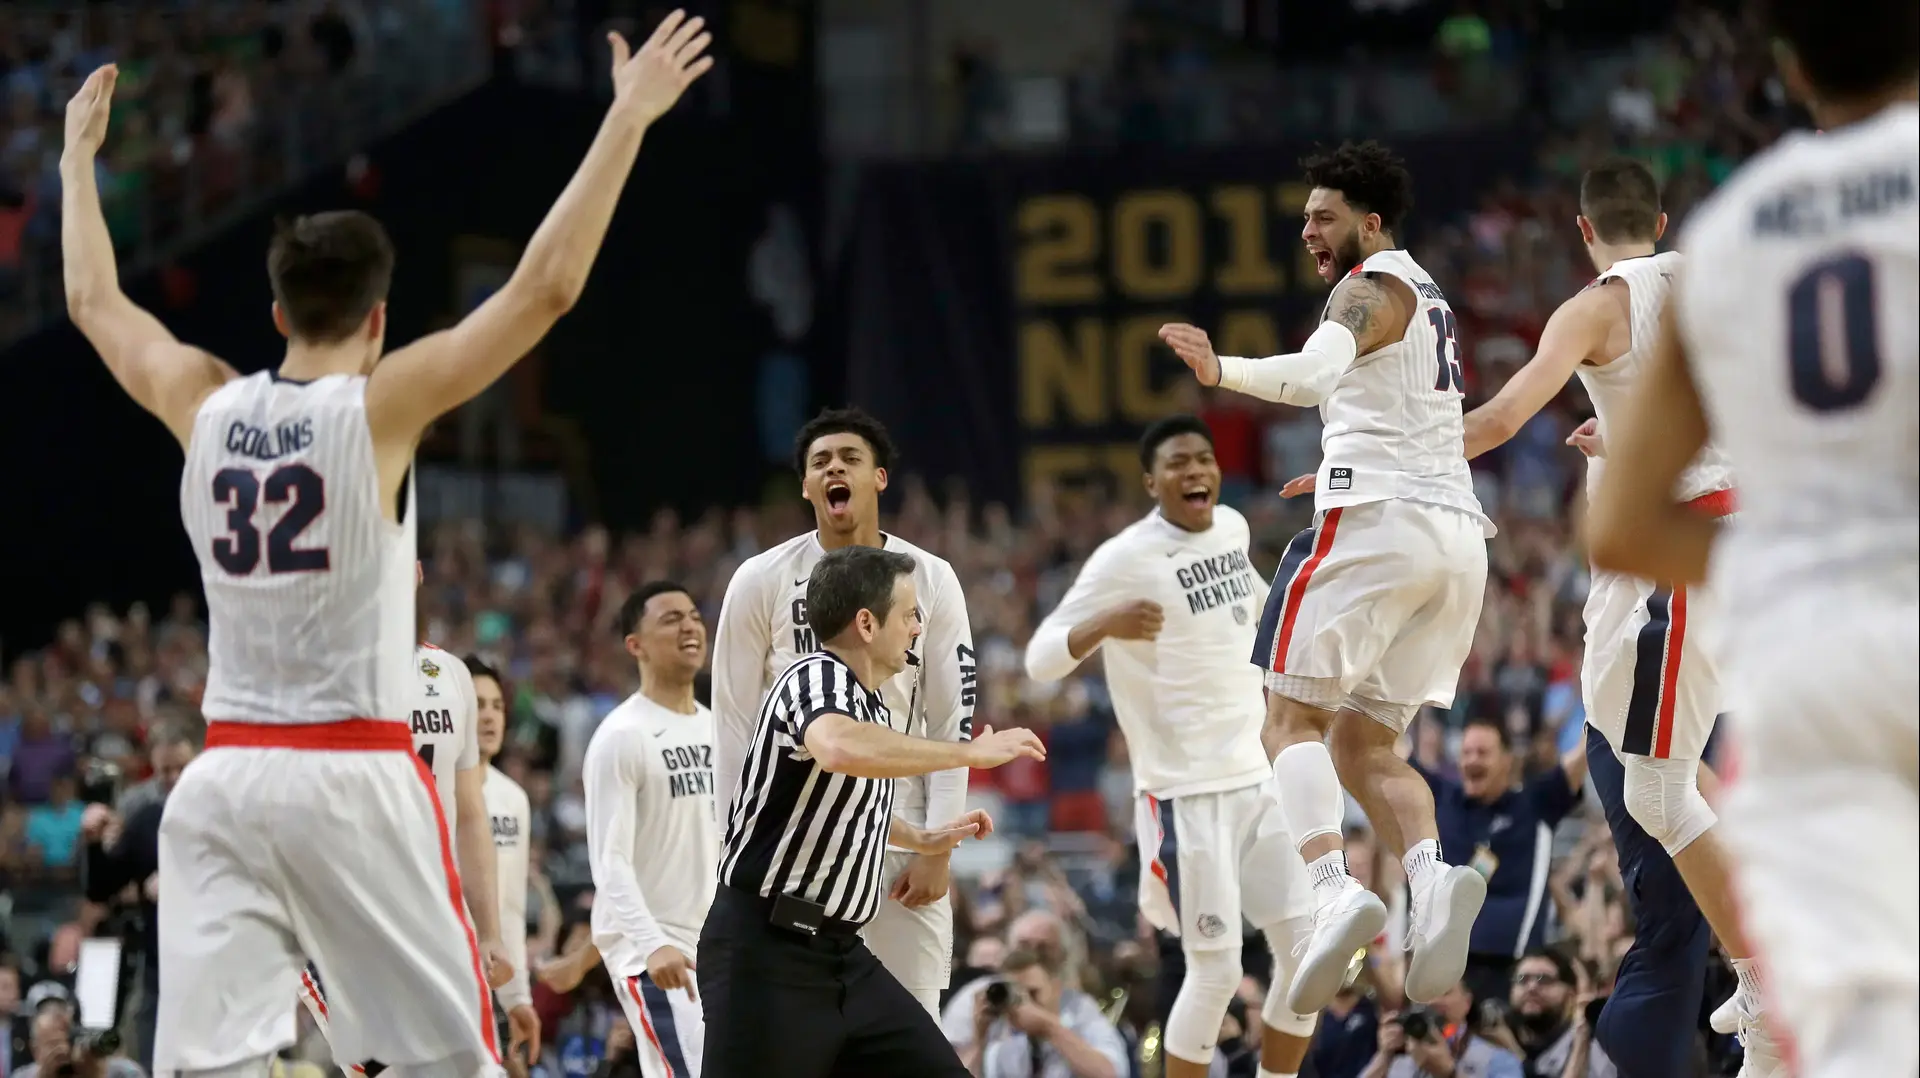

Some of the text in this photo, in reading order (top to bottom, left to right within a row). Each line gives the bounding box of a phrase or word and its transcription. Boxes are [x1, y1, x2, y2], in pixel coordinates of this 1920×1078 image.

[1789, 249, 1882, 413] 0
[226, 419, 314, 460] COLLINS
[212, 461, 330, 577] 32
[409, 709, 454, 734] AGA
[662, 745, 713, 770] GONZ
